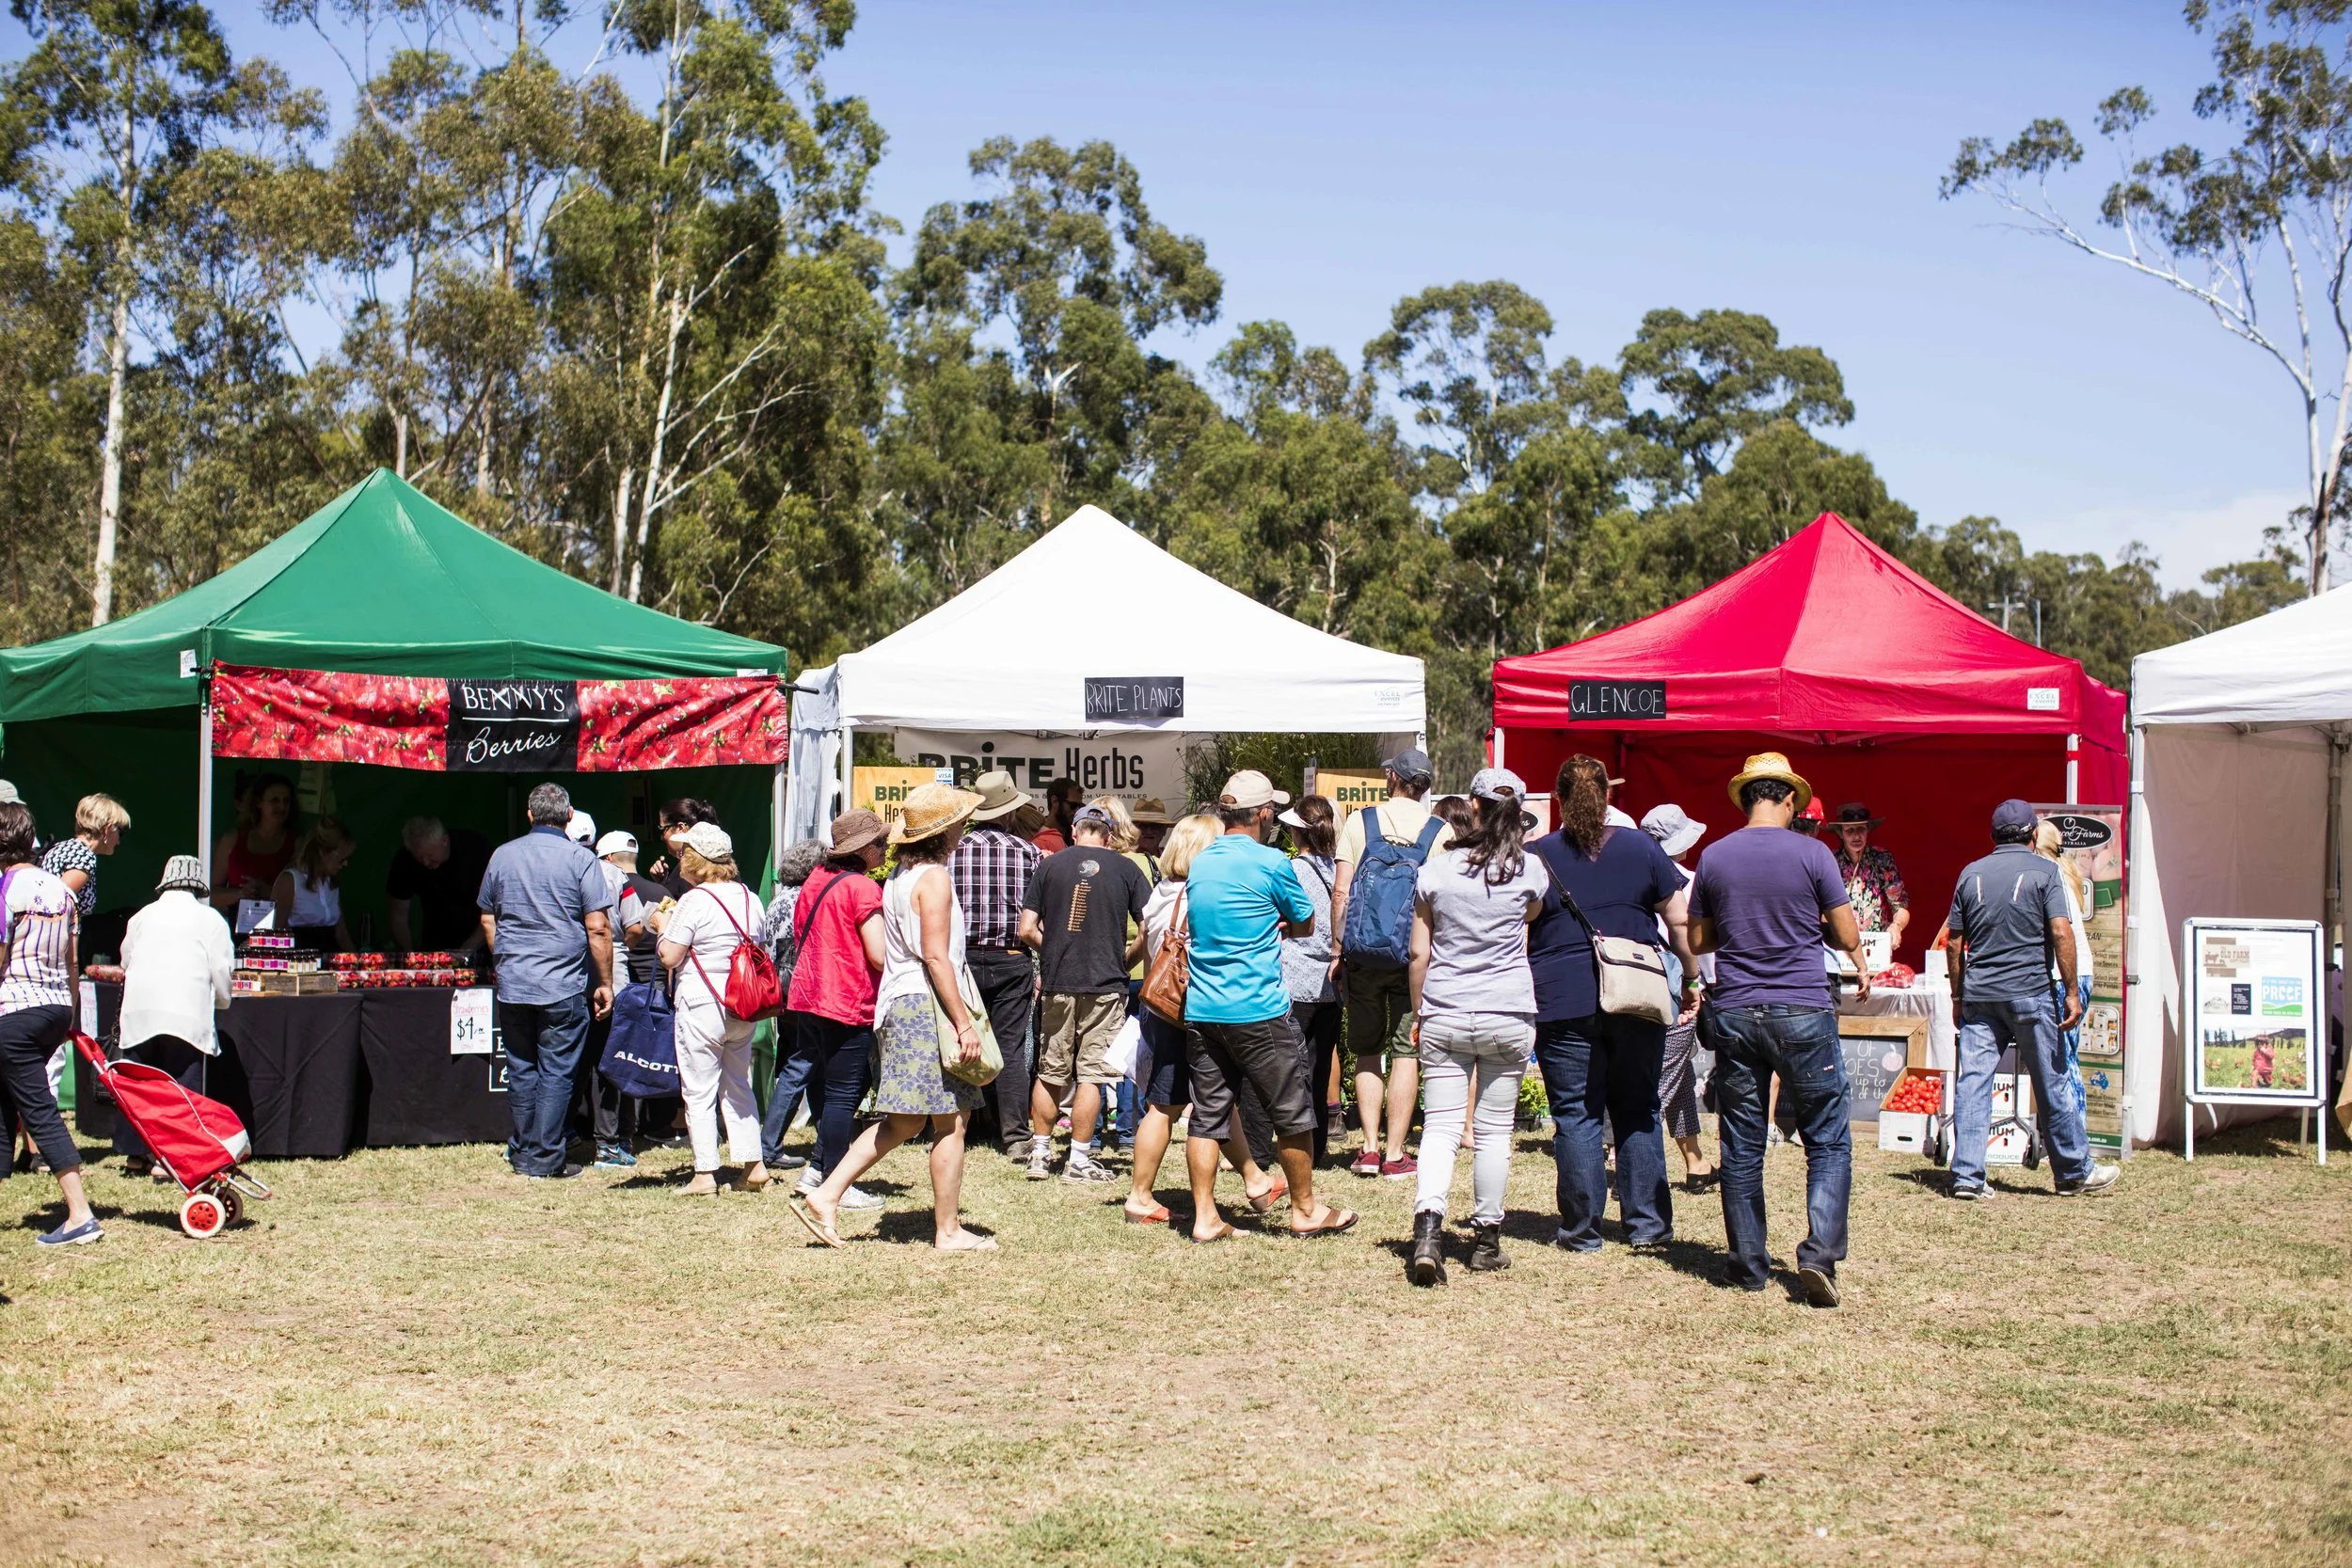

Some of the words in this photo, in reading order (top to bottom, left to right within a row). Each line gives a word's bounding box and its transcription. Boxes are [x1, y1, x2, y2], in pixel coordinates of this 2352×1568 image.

[462, 686, 565, 712] BENNY'S
[1085, 682, 1128, 714] BRITE
[1133, 684, 1183, 711] PLANTS
[1571, 685, 1664, 714] GLENCOE
[466, 726, 562, 763] Berries
[1065, 747, 1144, 790] Herbs
[1843, 1057, 1880, 1078] OES
[1855, 1077, 1869, 1093] up
[1874, 1077, 1887, 1087] to
[1858, 1086, 1869, 1100] of
